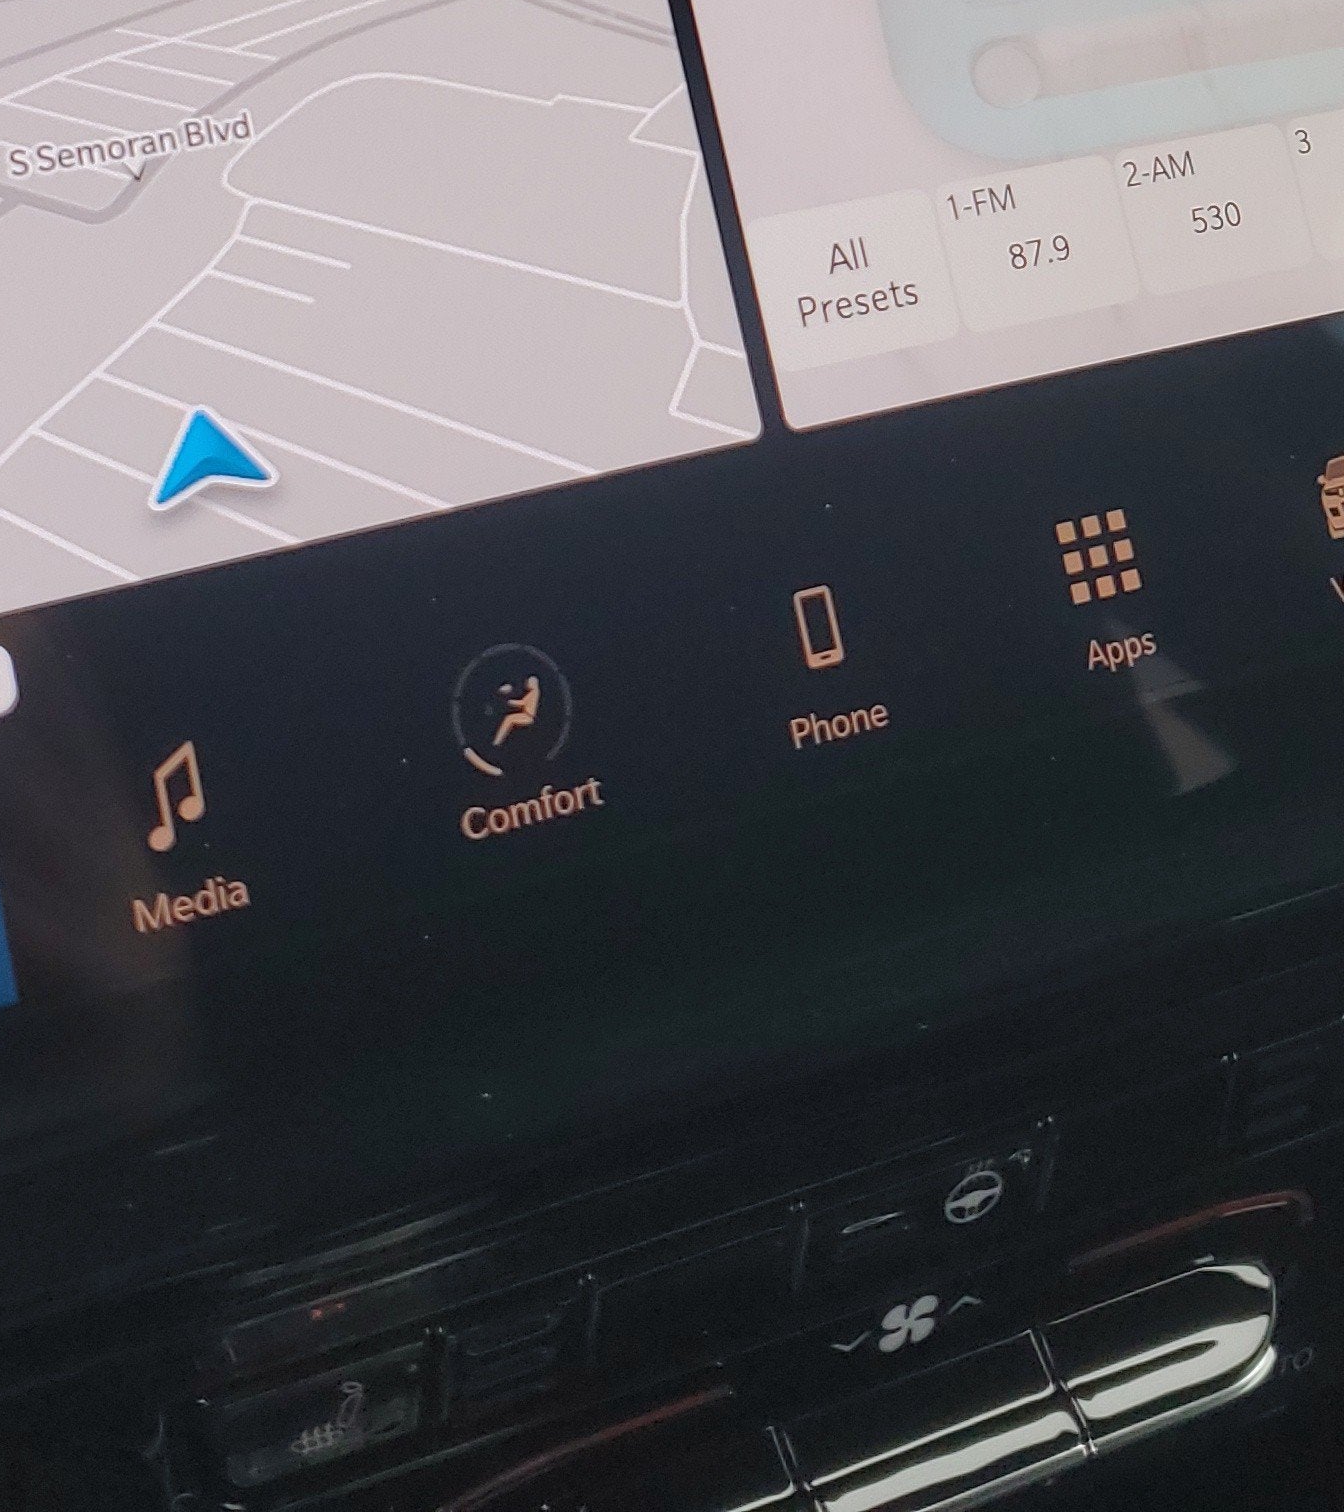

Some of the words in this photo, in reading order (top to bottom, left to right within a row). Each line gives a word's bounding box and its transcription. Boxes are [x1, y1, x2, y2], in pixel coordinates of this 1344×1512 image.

[10, 149, 30, 176] S
[36, 130, 177, 171] Semoran
[184, 112, 251, 148] Blvd
[1294, 129, 1311, 154] 3
[1122, 150, 1196, 188] 2-AM
[946, 183, 1017, 221] 1-FM
[1191, 201, 1242, 234] 530
[828, 236, 869, 275] All
[1008, 234, 1071, 271] 87.9
[797, 280, 919, 328] Presets
[1087, 630, 1157, 672] Apps
[789, 703, 889, 749] Phone
[461, 777, 604, 840] Comfort
[132, 876, 250, 933] Media
